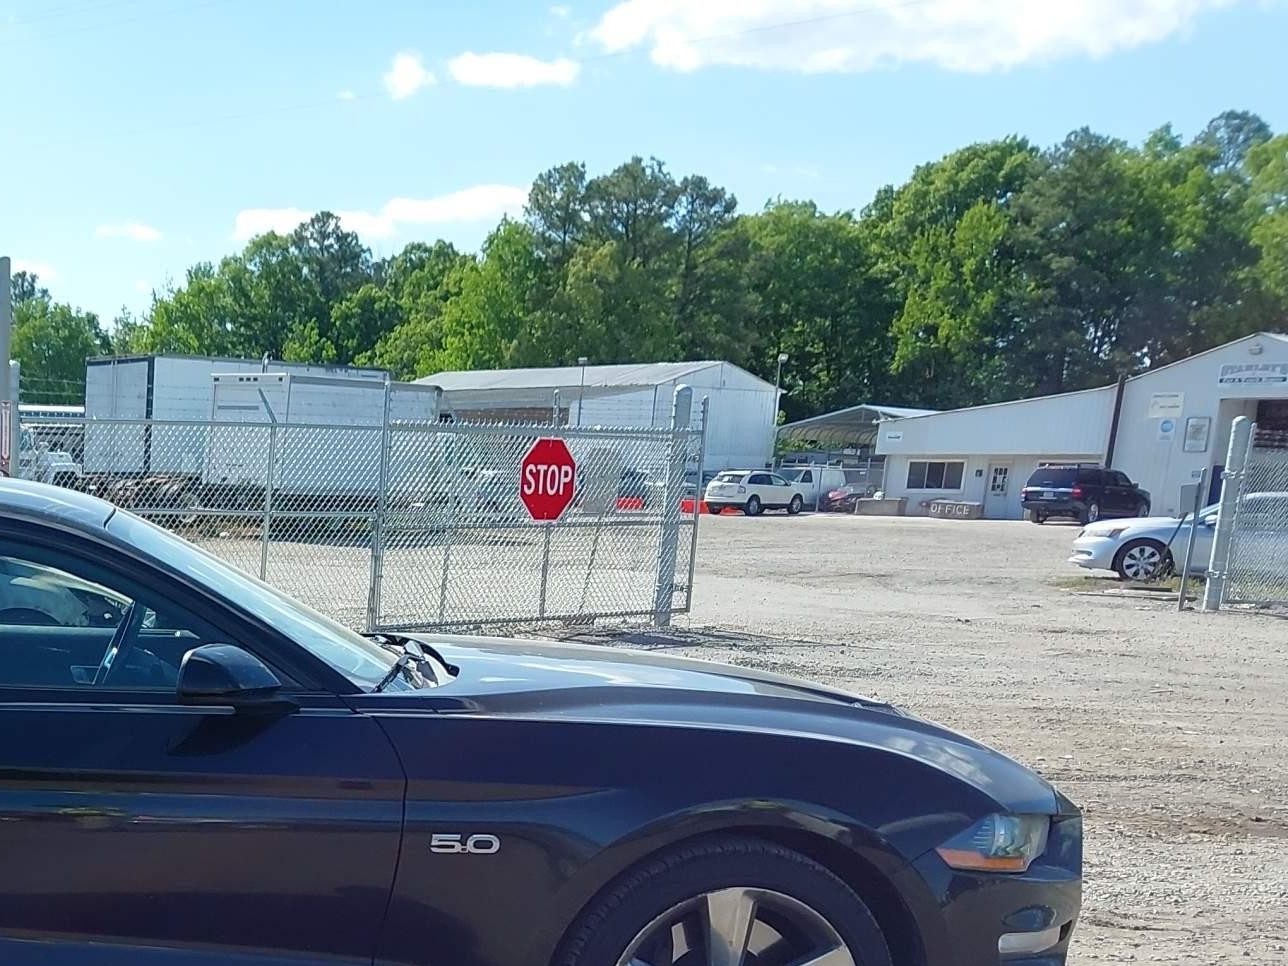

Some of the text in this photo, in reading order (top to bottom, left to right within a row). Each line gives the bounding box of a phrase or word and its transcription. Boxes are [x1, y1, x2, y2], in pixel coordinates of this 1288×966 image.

[523, 463, 573, 496] STOP
[930, 503, 969, 515] OFFICE
[430, 833, 500, 854] 5.0
